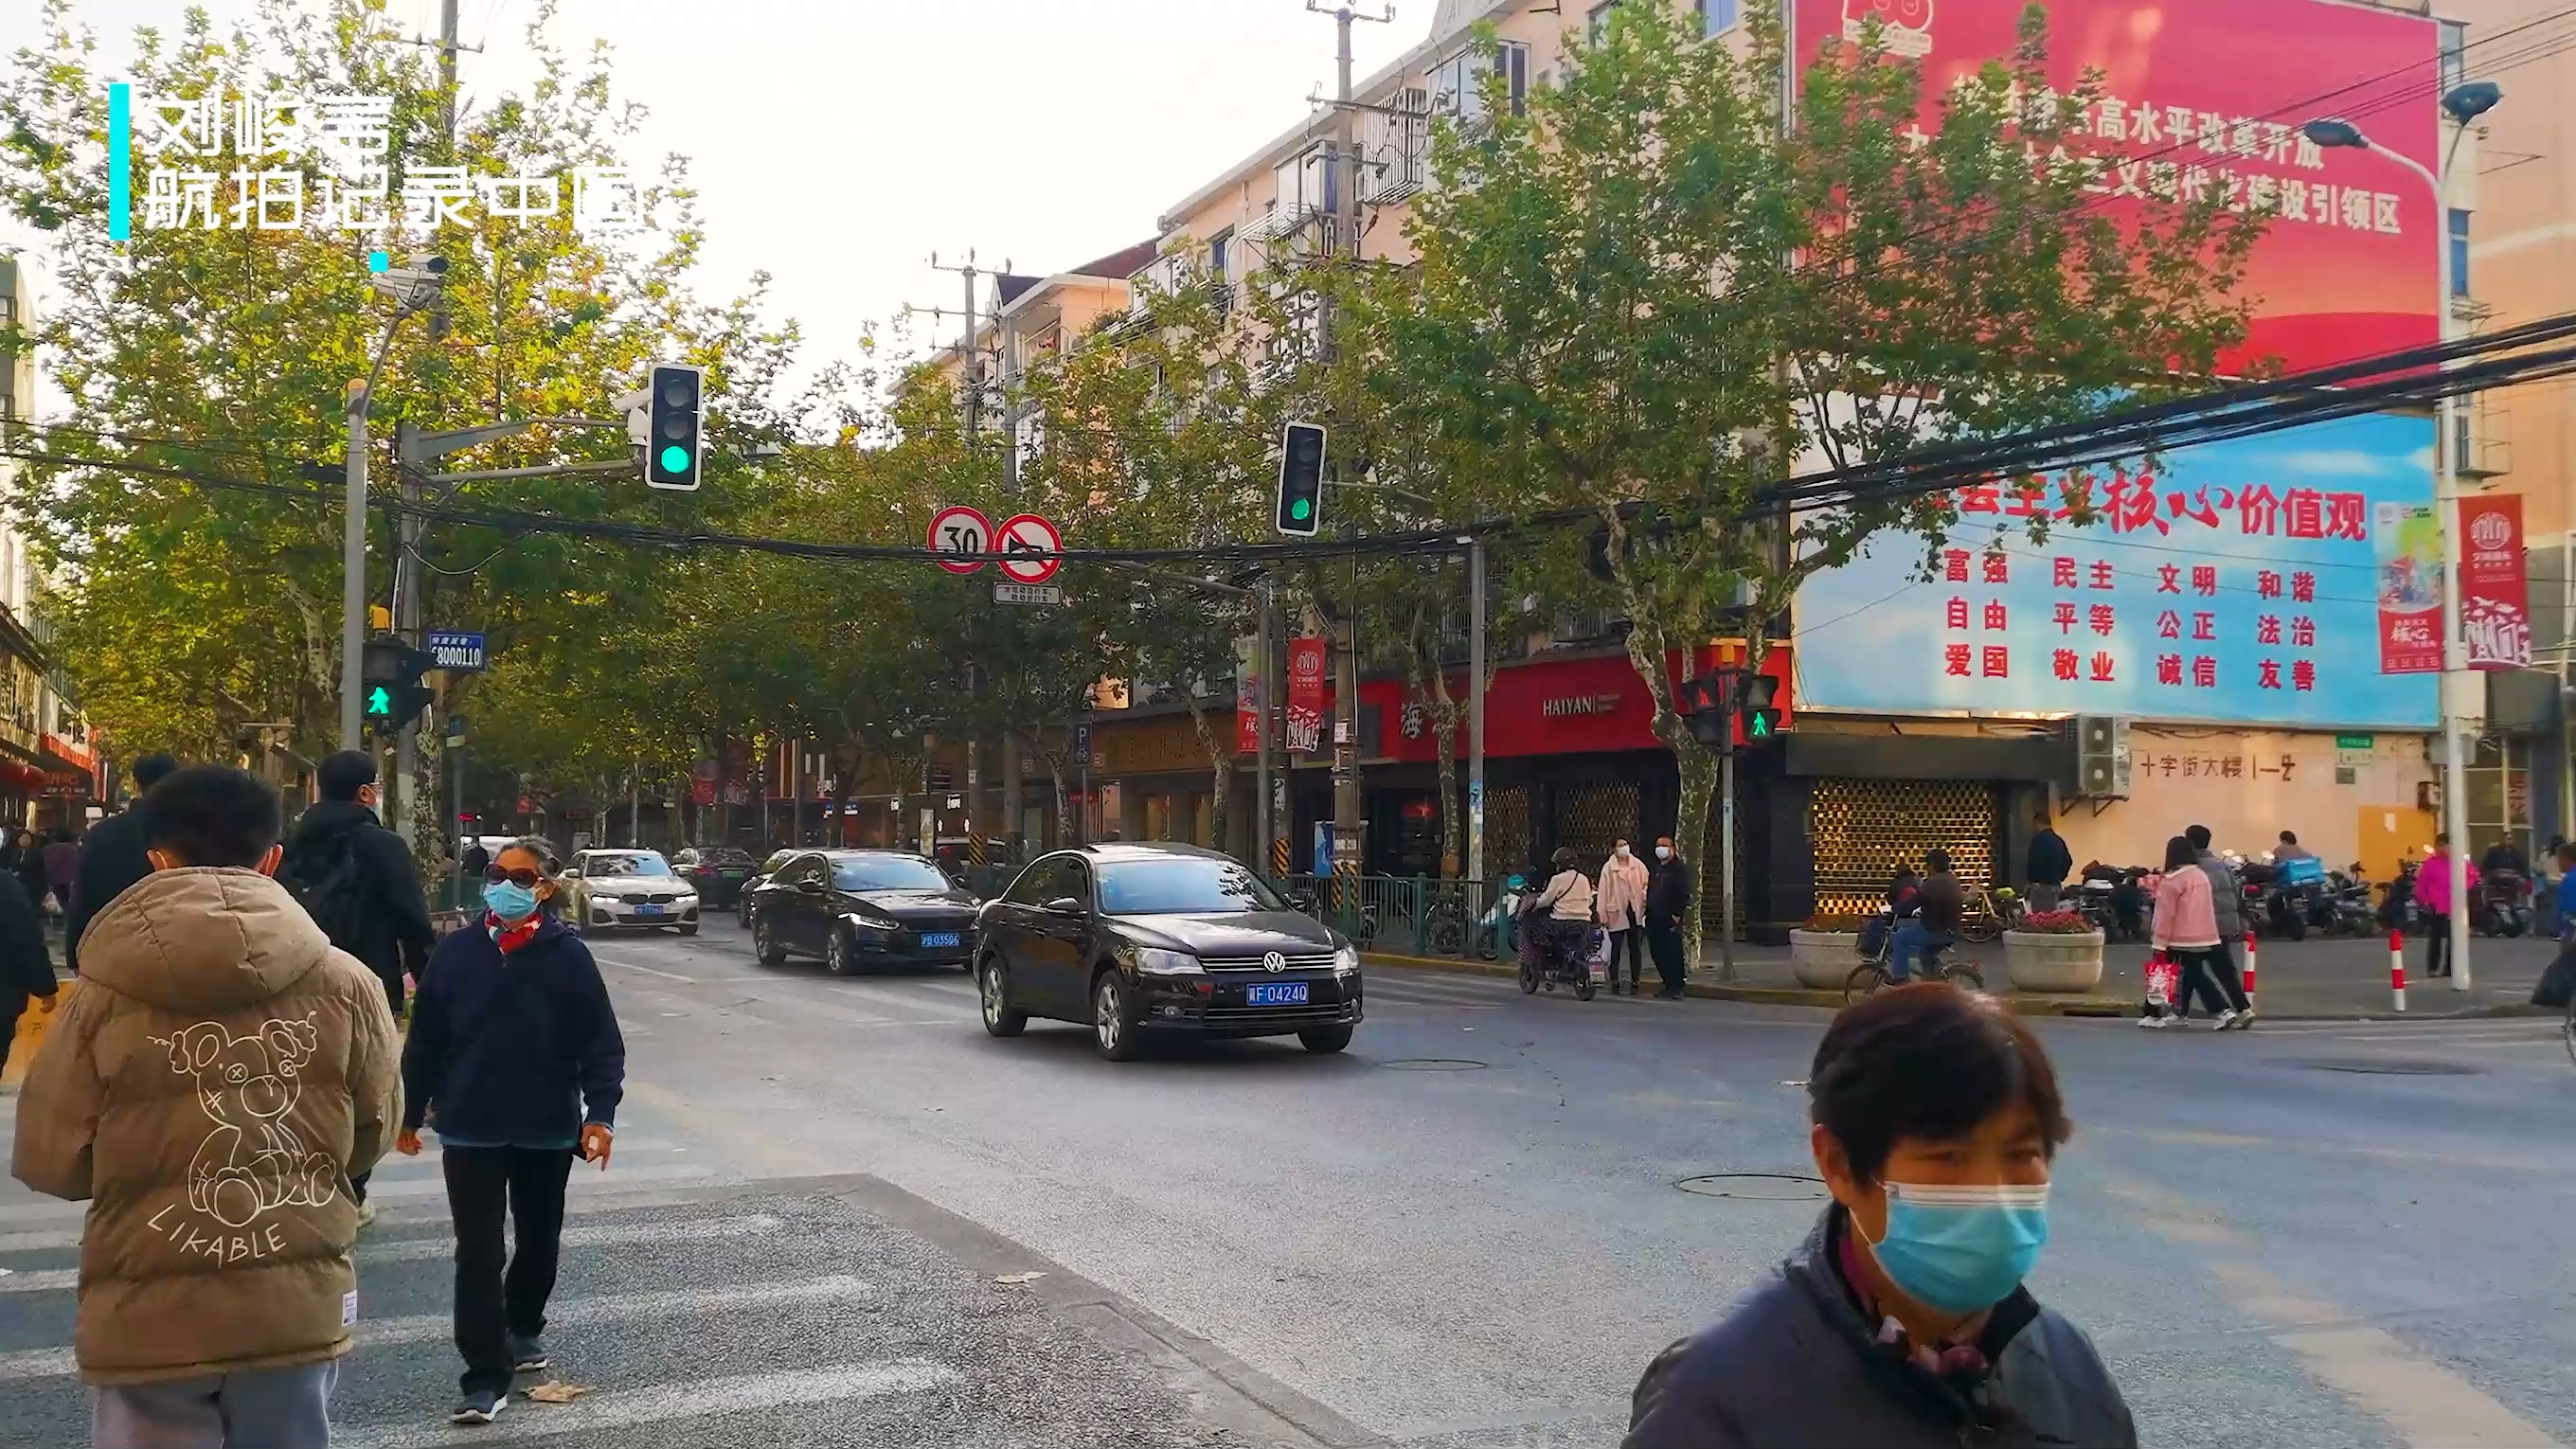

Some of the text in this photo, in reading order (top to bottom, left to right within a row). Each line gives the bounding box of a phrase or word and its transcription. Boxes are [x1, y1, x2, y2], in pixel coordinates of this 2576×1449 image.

[1913, 464, 2367, 542] 会主义核心价值观
[944, 527, 978, 553] 30
[1944, 548, 2317, 603] 富强 民主 文明 和谐
[1945, 596, 2316, 647] 自由 平等 公正 法治
[1944, 643, 2317, 691] 爱国 敬业 诚信 友善
[1543, 696, 1593, 717] HAIYAN
[1079, 727, 1088, 743] P
[147, 1203, 287, 1269] LIKABLE
